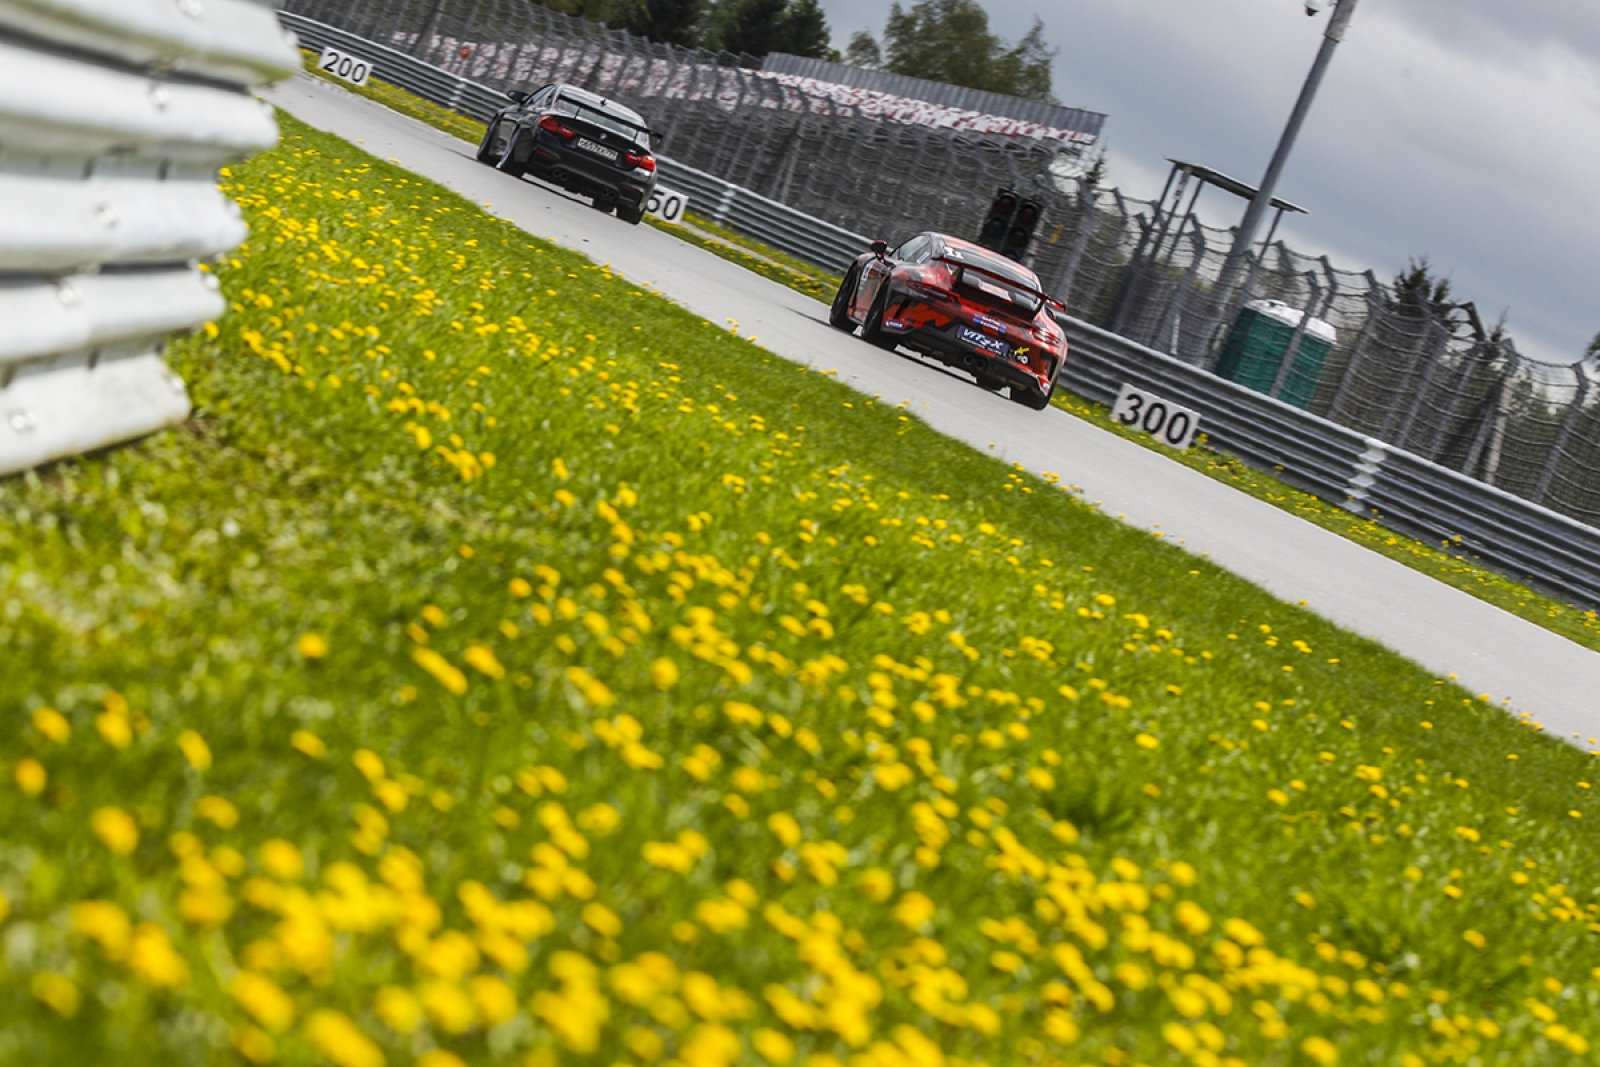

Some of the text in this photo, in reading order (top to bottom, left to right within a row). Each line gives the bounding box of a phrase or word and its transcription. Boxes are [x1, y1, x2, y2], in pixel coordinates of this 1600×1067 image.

[323, 51, 367, 83] 200
[645, 189, 681, 221] 50
[1119, 393, 1190, 445] 300
